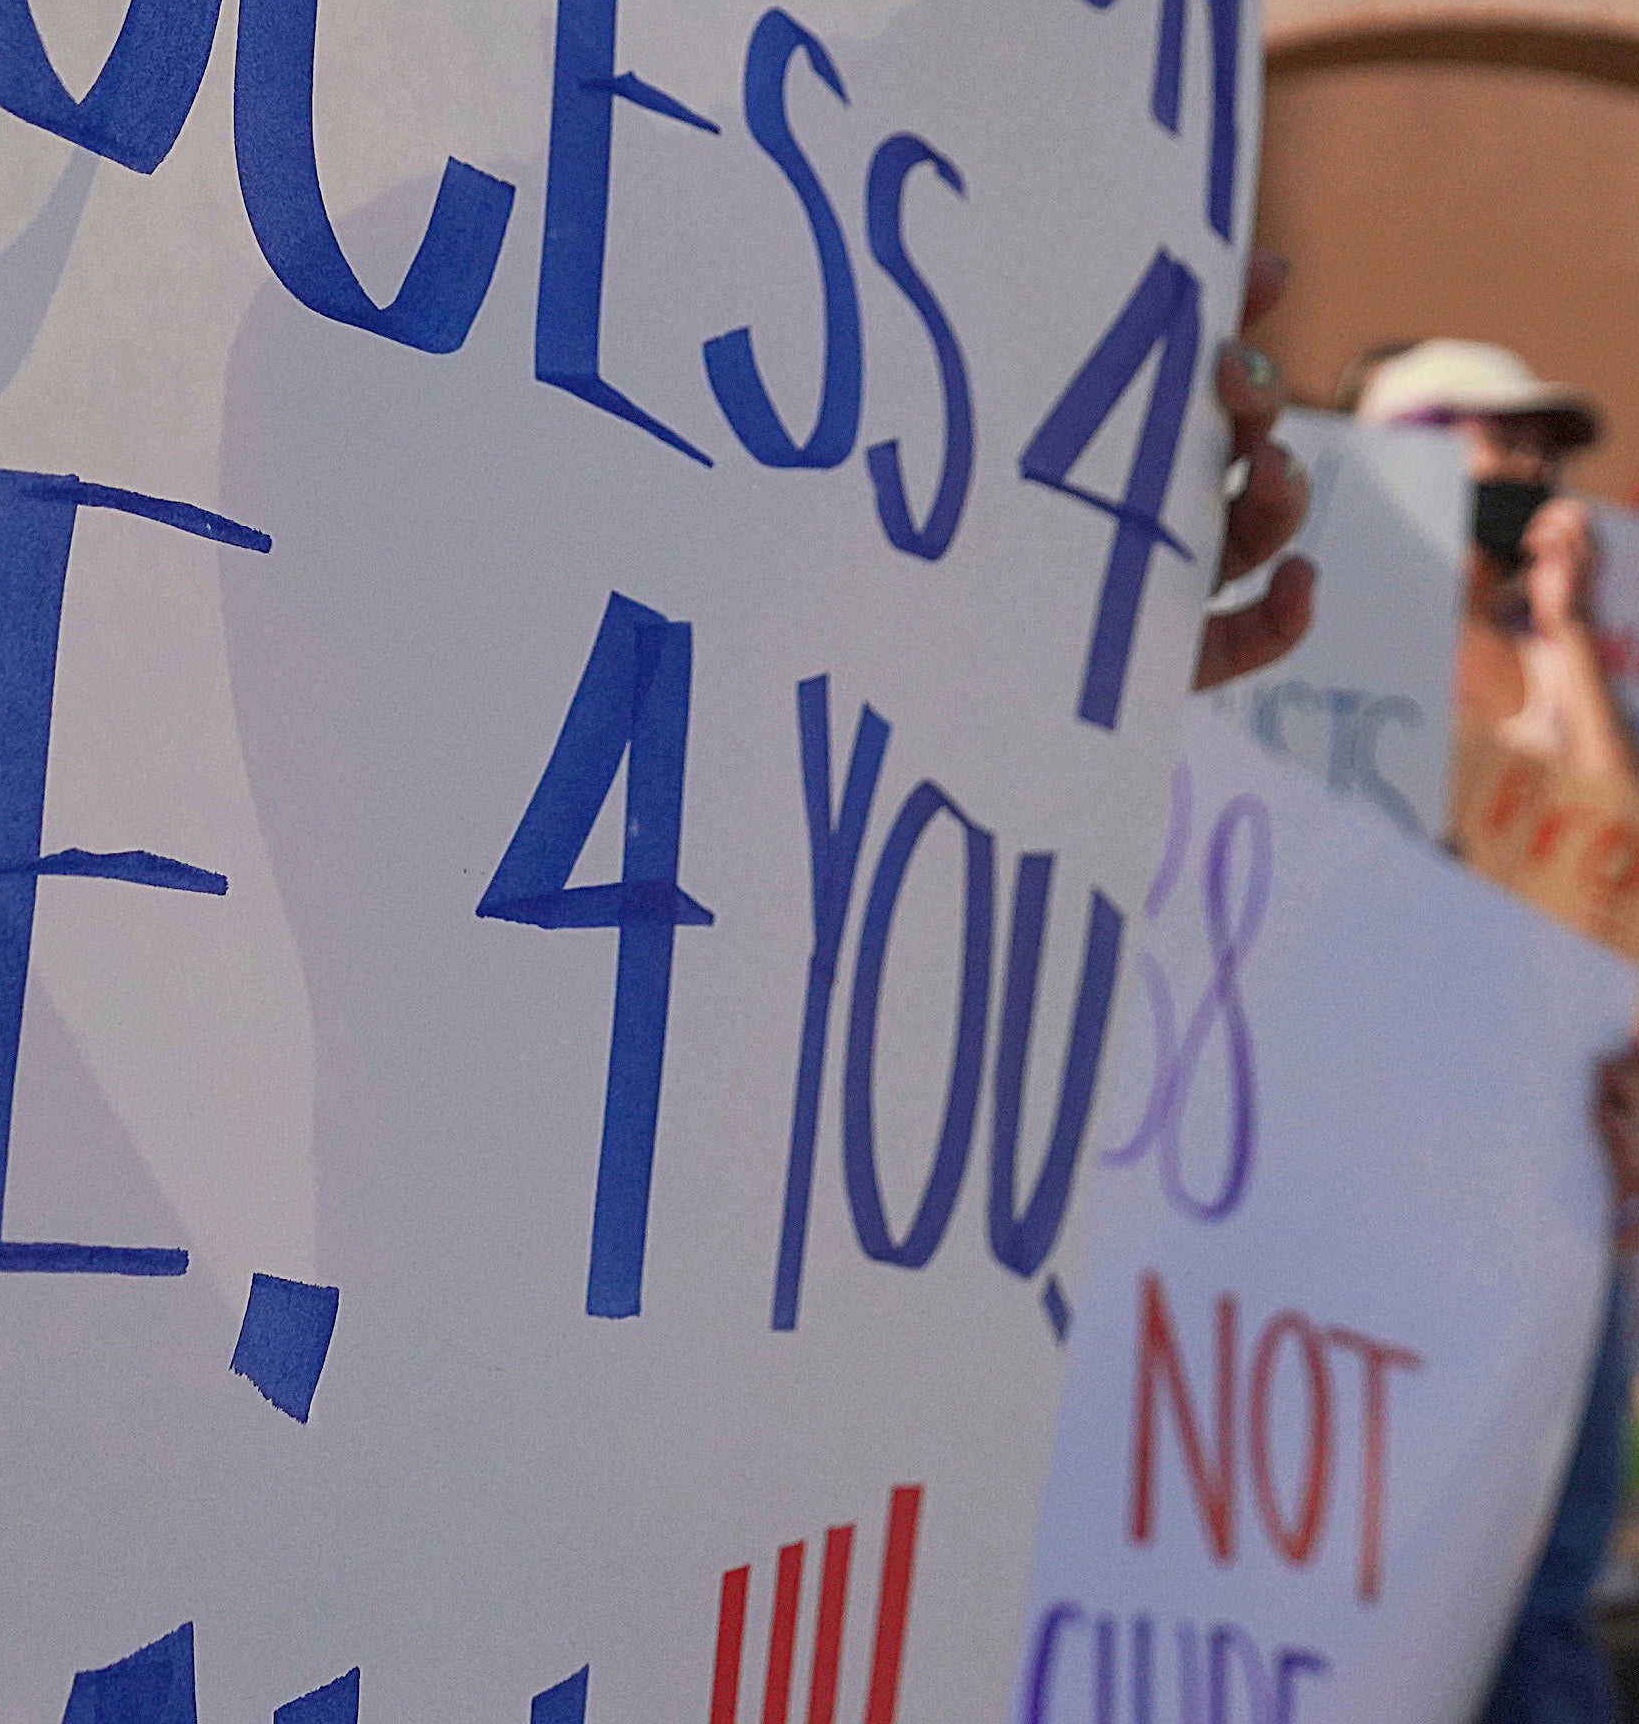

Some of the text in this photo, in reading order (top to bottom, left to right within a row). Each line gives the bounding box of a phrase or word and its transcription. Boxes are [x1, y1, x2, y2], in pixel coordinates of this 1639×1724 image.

[1018, 246, 1198, 731] 4
[474, 590, 716, 1319] 4
[1126, 1266, 1427, 1608] NOT
